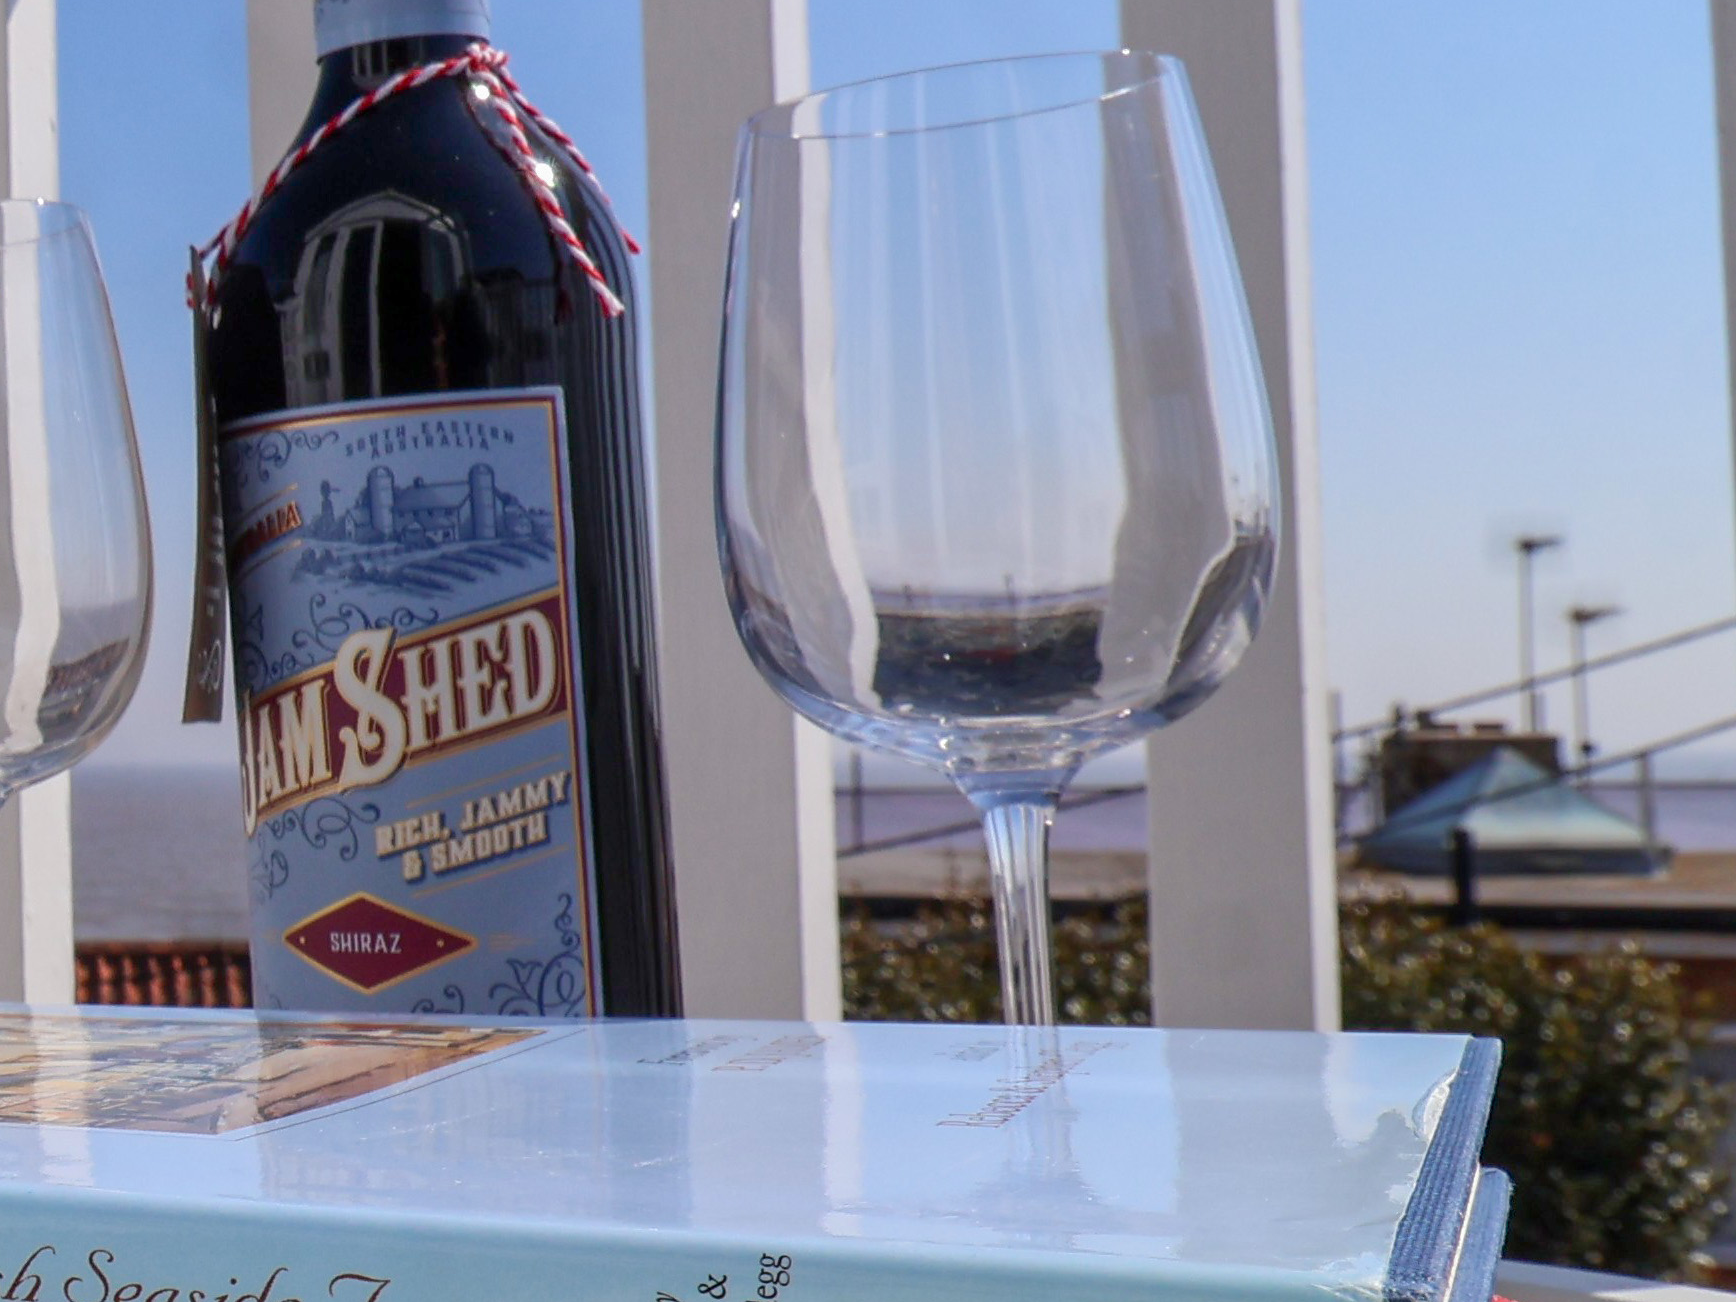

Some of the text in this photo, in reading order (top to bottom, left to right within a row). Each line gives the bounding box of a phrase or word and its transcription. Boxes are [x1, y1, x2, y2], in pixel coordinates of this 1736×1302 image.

[240, 608, 559, 836] JAM SHED
[374, 769, 572, 858] RICH, JAMMY
[401, 811, 550, 885] & SMOOTH
[329, 931, 403, 954] SHIRAZ
[697, 1273, 728, 1300] &
